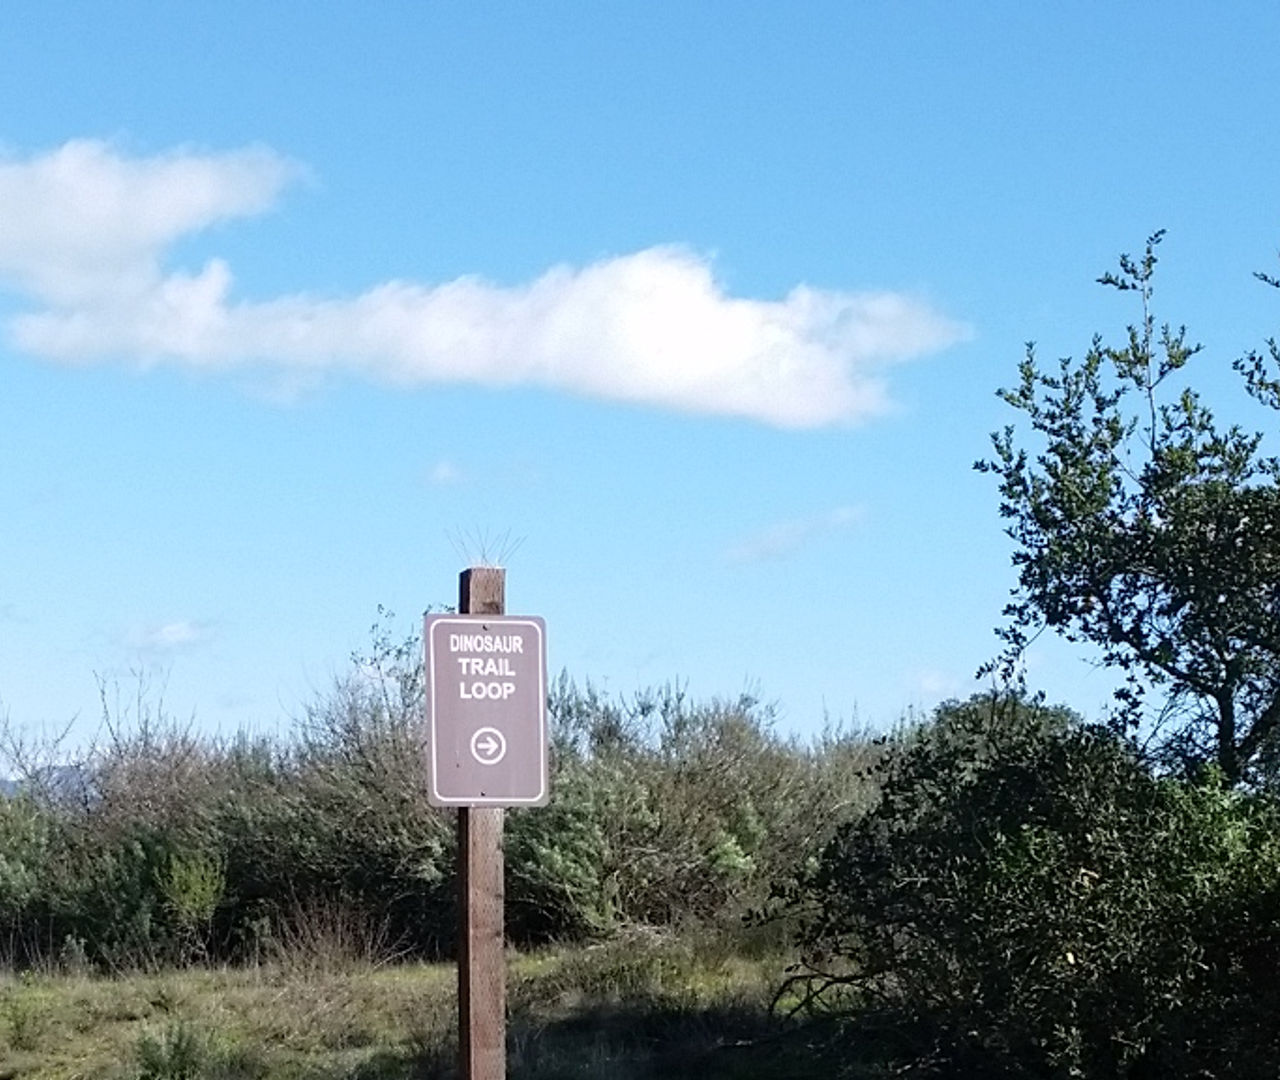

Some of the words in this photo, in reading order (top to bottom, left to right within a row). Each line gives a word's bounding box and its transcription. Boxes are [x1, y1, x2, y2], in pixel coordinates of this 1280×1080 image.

[450, 634, 523, 653] DINOSAUR
[458, 658, 516, 676] TRAIL
[460, 682, 515, 699] LOOP
